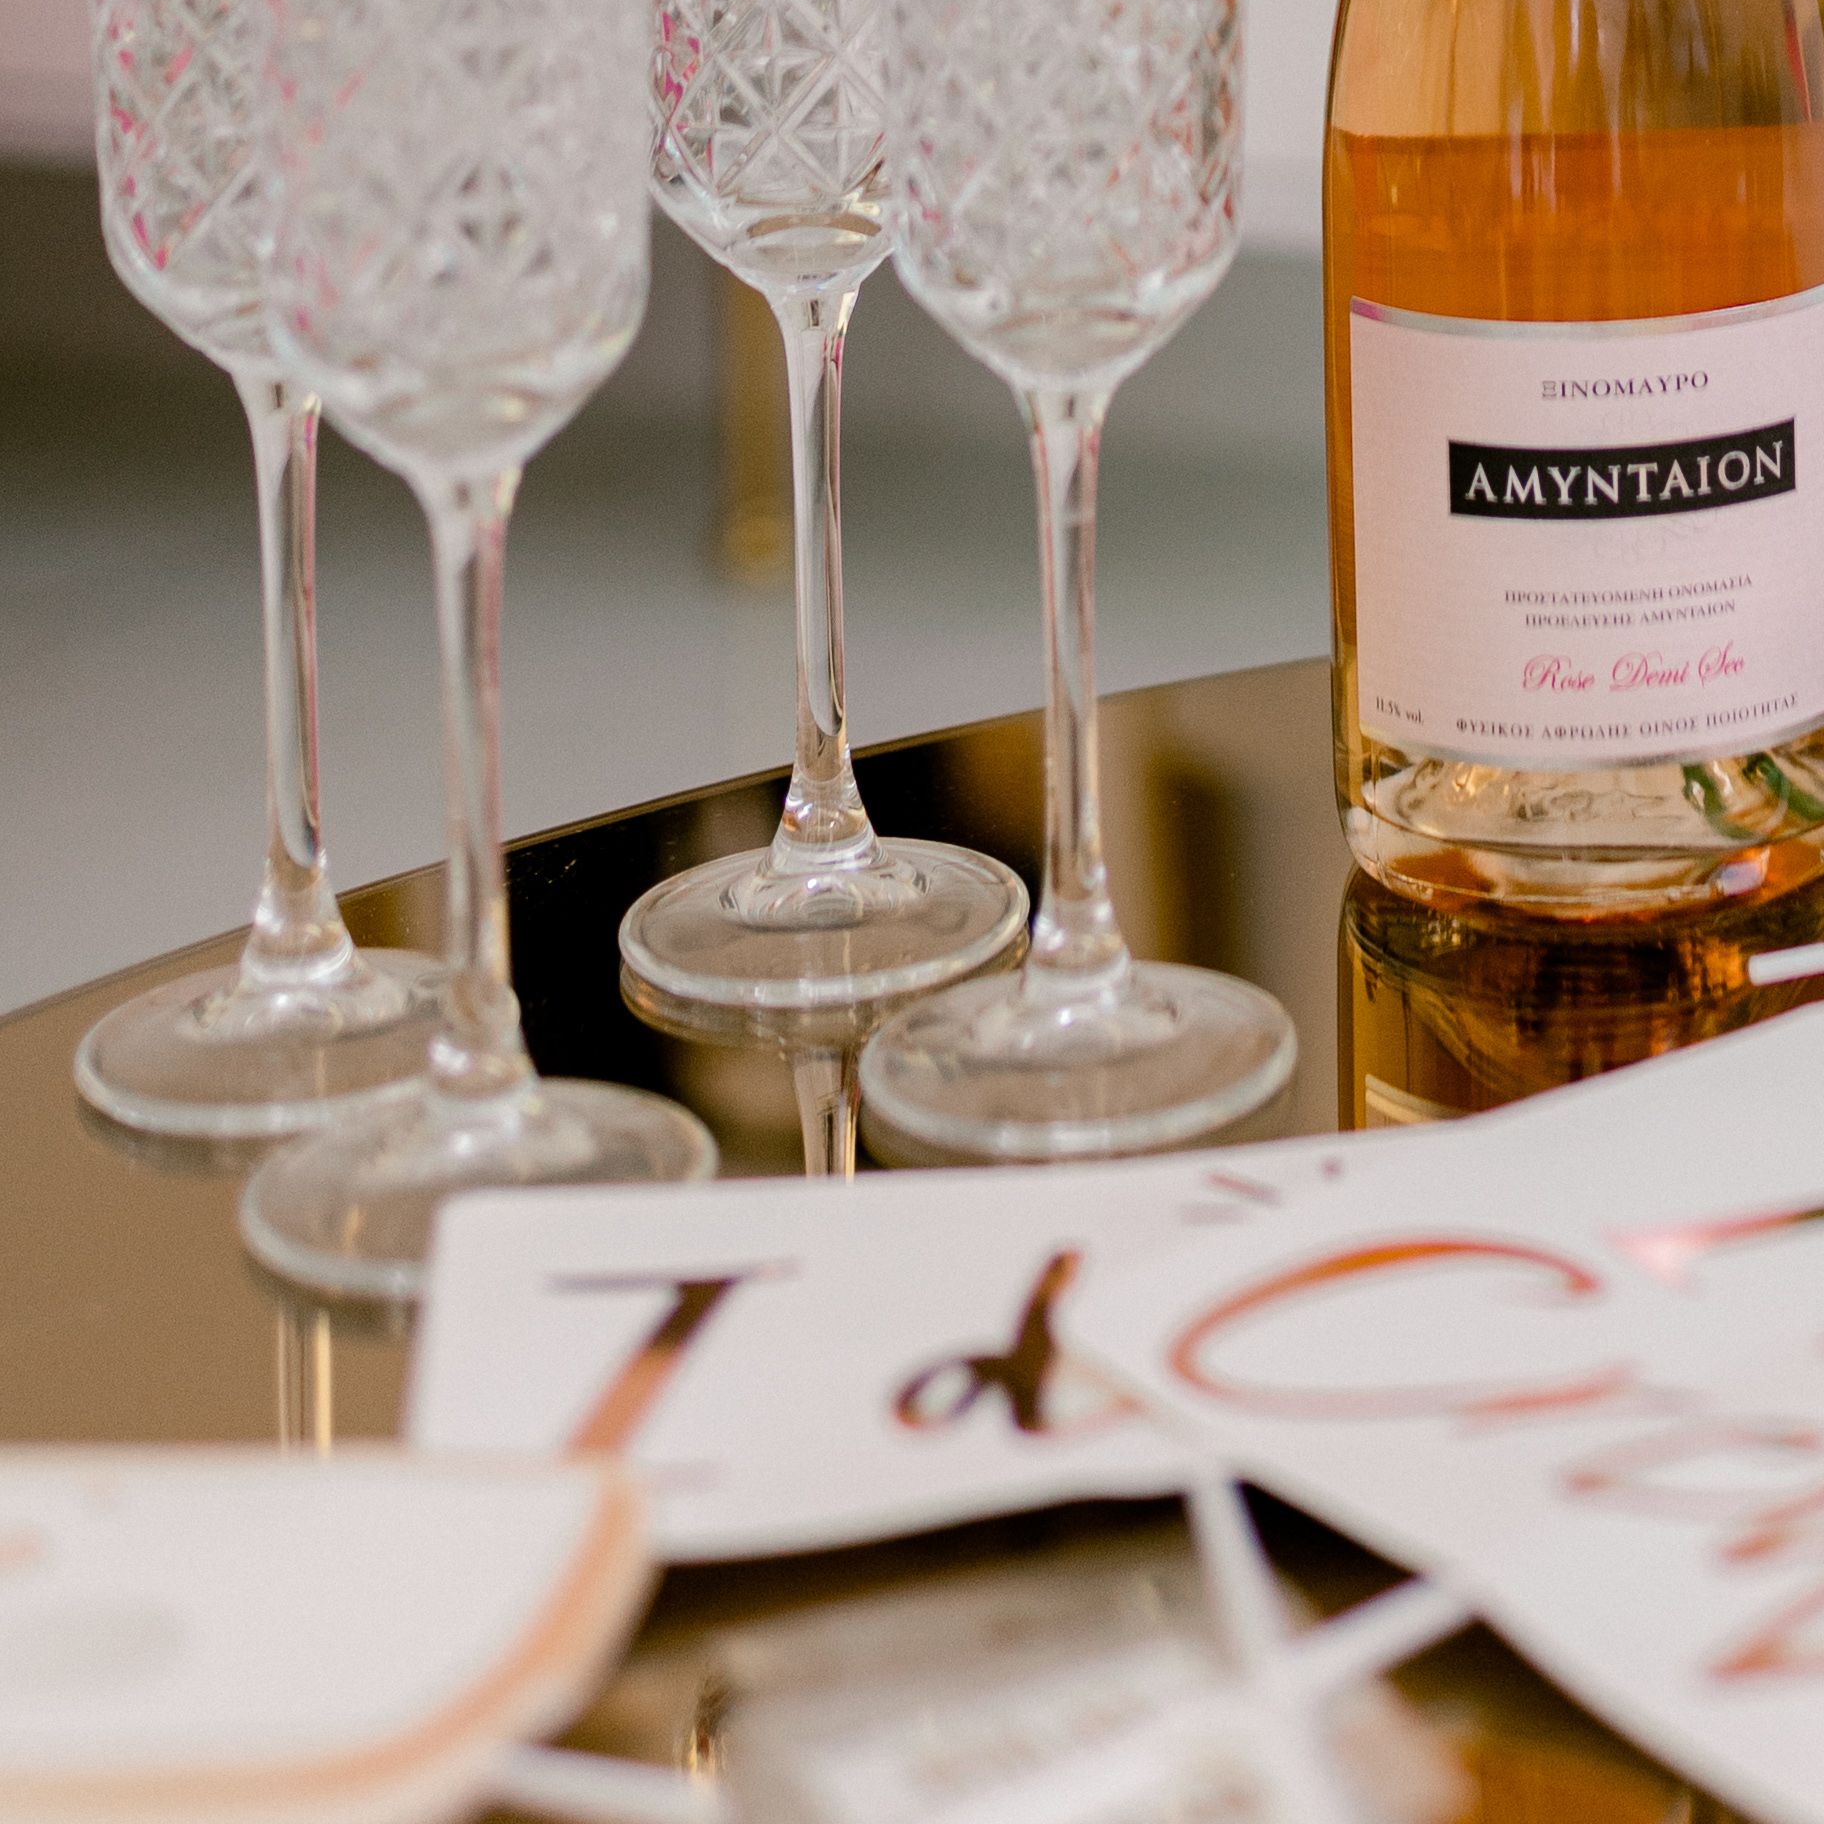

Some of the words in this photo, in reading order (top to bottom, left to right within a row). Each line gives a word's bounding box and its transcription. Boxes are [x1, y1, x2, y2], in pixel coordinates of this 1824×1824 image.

[1542, 370, 1709, 399] ΞΙΝΟΜΑΥΡΟ
[1464, 440, 1784, 506] AMYNTAION
[1504, 587, 1664, 606] ΠΡΟΣΤΑΤΕΥΟΜΕΝΗ
[1668, 573, 1753, 598] ΟΝΟΜΑΣΙΑ
[1525, 612, 1632, 628] ΠΡΟΕΛΕΥΣΗΣ
[1640, 599, 1736, 625] ΑΜΥΝΤΑΙΟΝ
[1522, 653, 1595, 693] Rose
[1608, 649, 1690, 692] Demi
[1697, 639, 1745, 688] Sec
[1405, 708, 1425, 727] vol.
[1455, 718, 1534, 739] ΦΥΣΙΚΟΣ
[1541, 724, 1632, 741] ΑΦΡΩΔΗΣ
[1639, 716, 1699, 737] ΟΙΝΟΣ
[1705, 691, 1799, 727] ΠΟΙΟΤΗΤΑΣ
